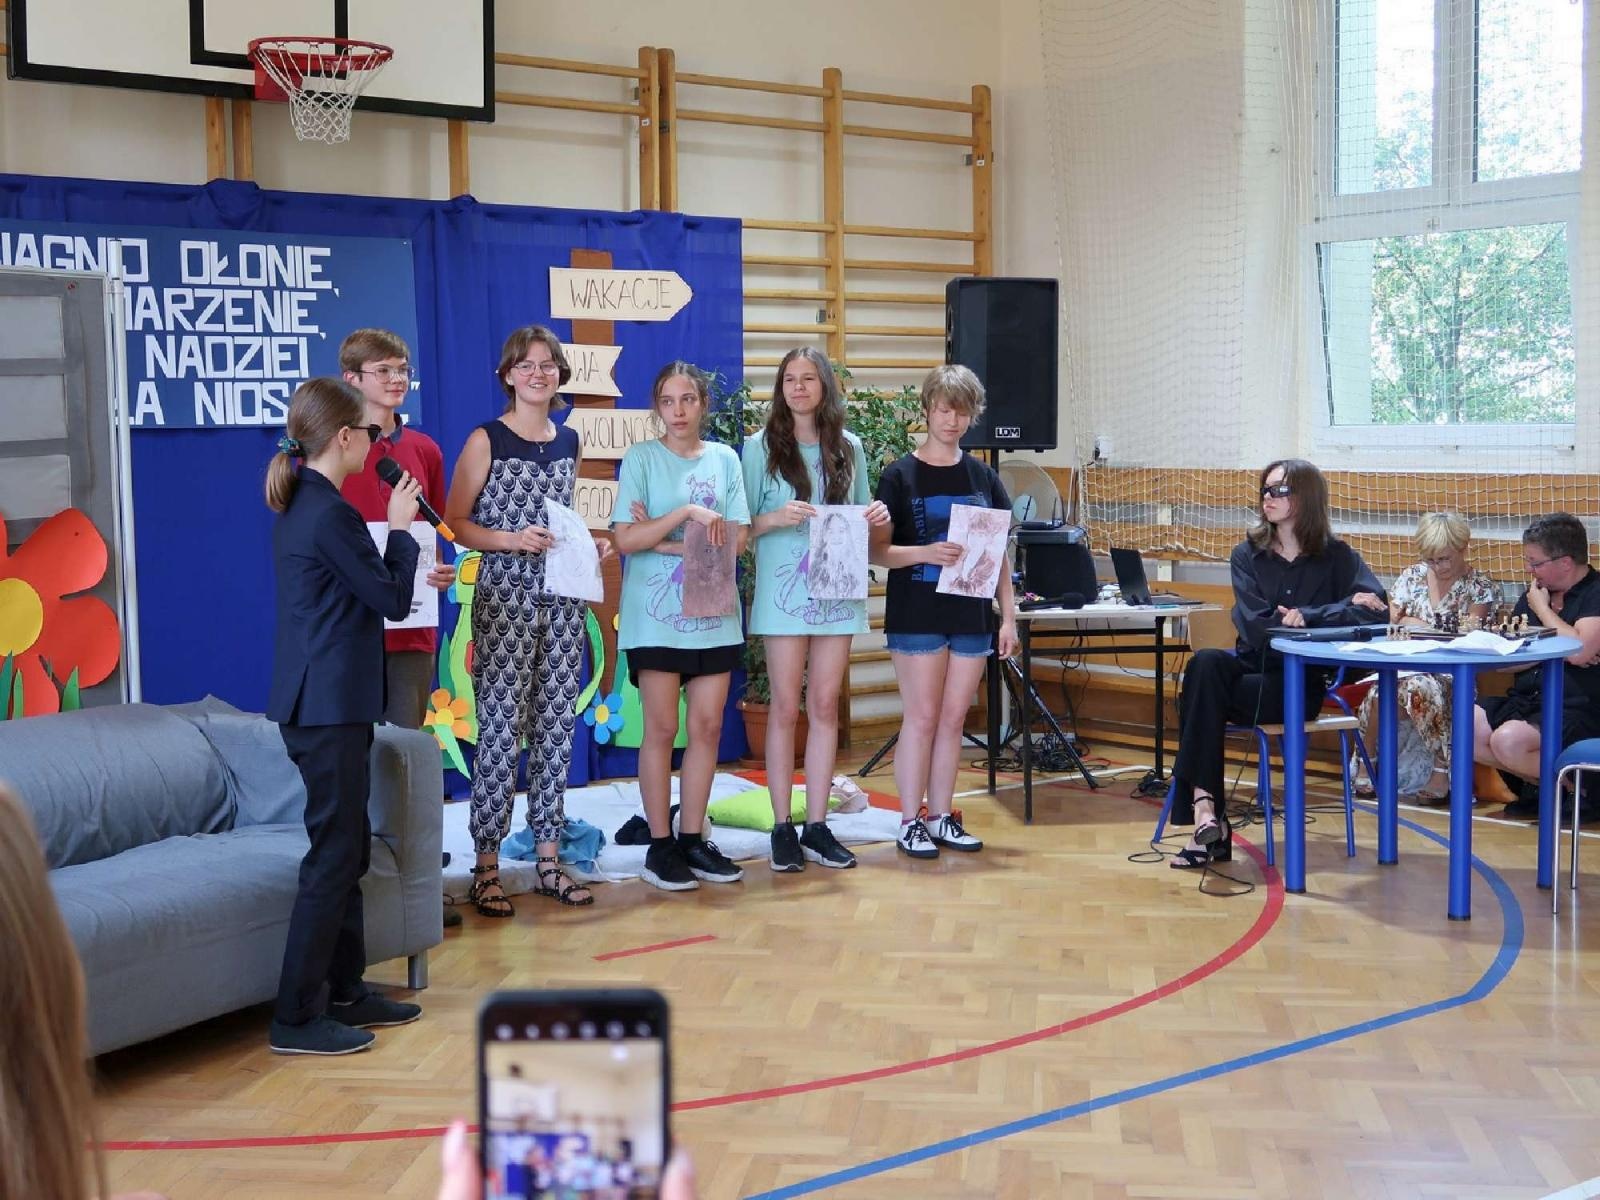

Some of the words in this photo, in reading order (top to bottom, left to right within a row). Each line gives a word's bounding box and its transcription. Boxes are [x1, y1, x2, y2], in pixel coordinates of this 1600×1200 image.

[570, 278, 671, 309] WAKACJE
[124, 286, 327, 340] ARZENIE,
[145, 335, 309, 379] NADZIEI
[194, 381, 303, 425] NIOS
[996, 428, 1020, 438] LDM
[575, 486, 613, 519] GOD
